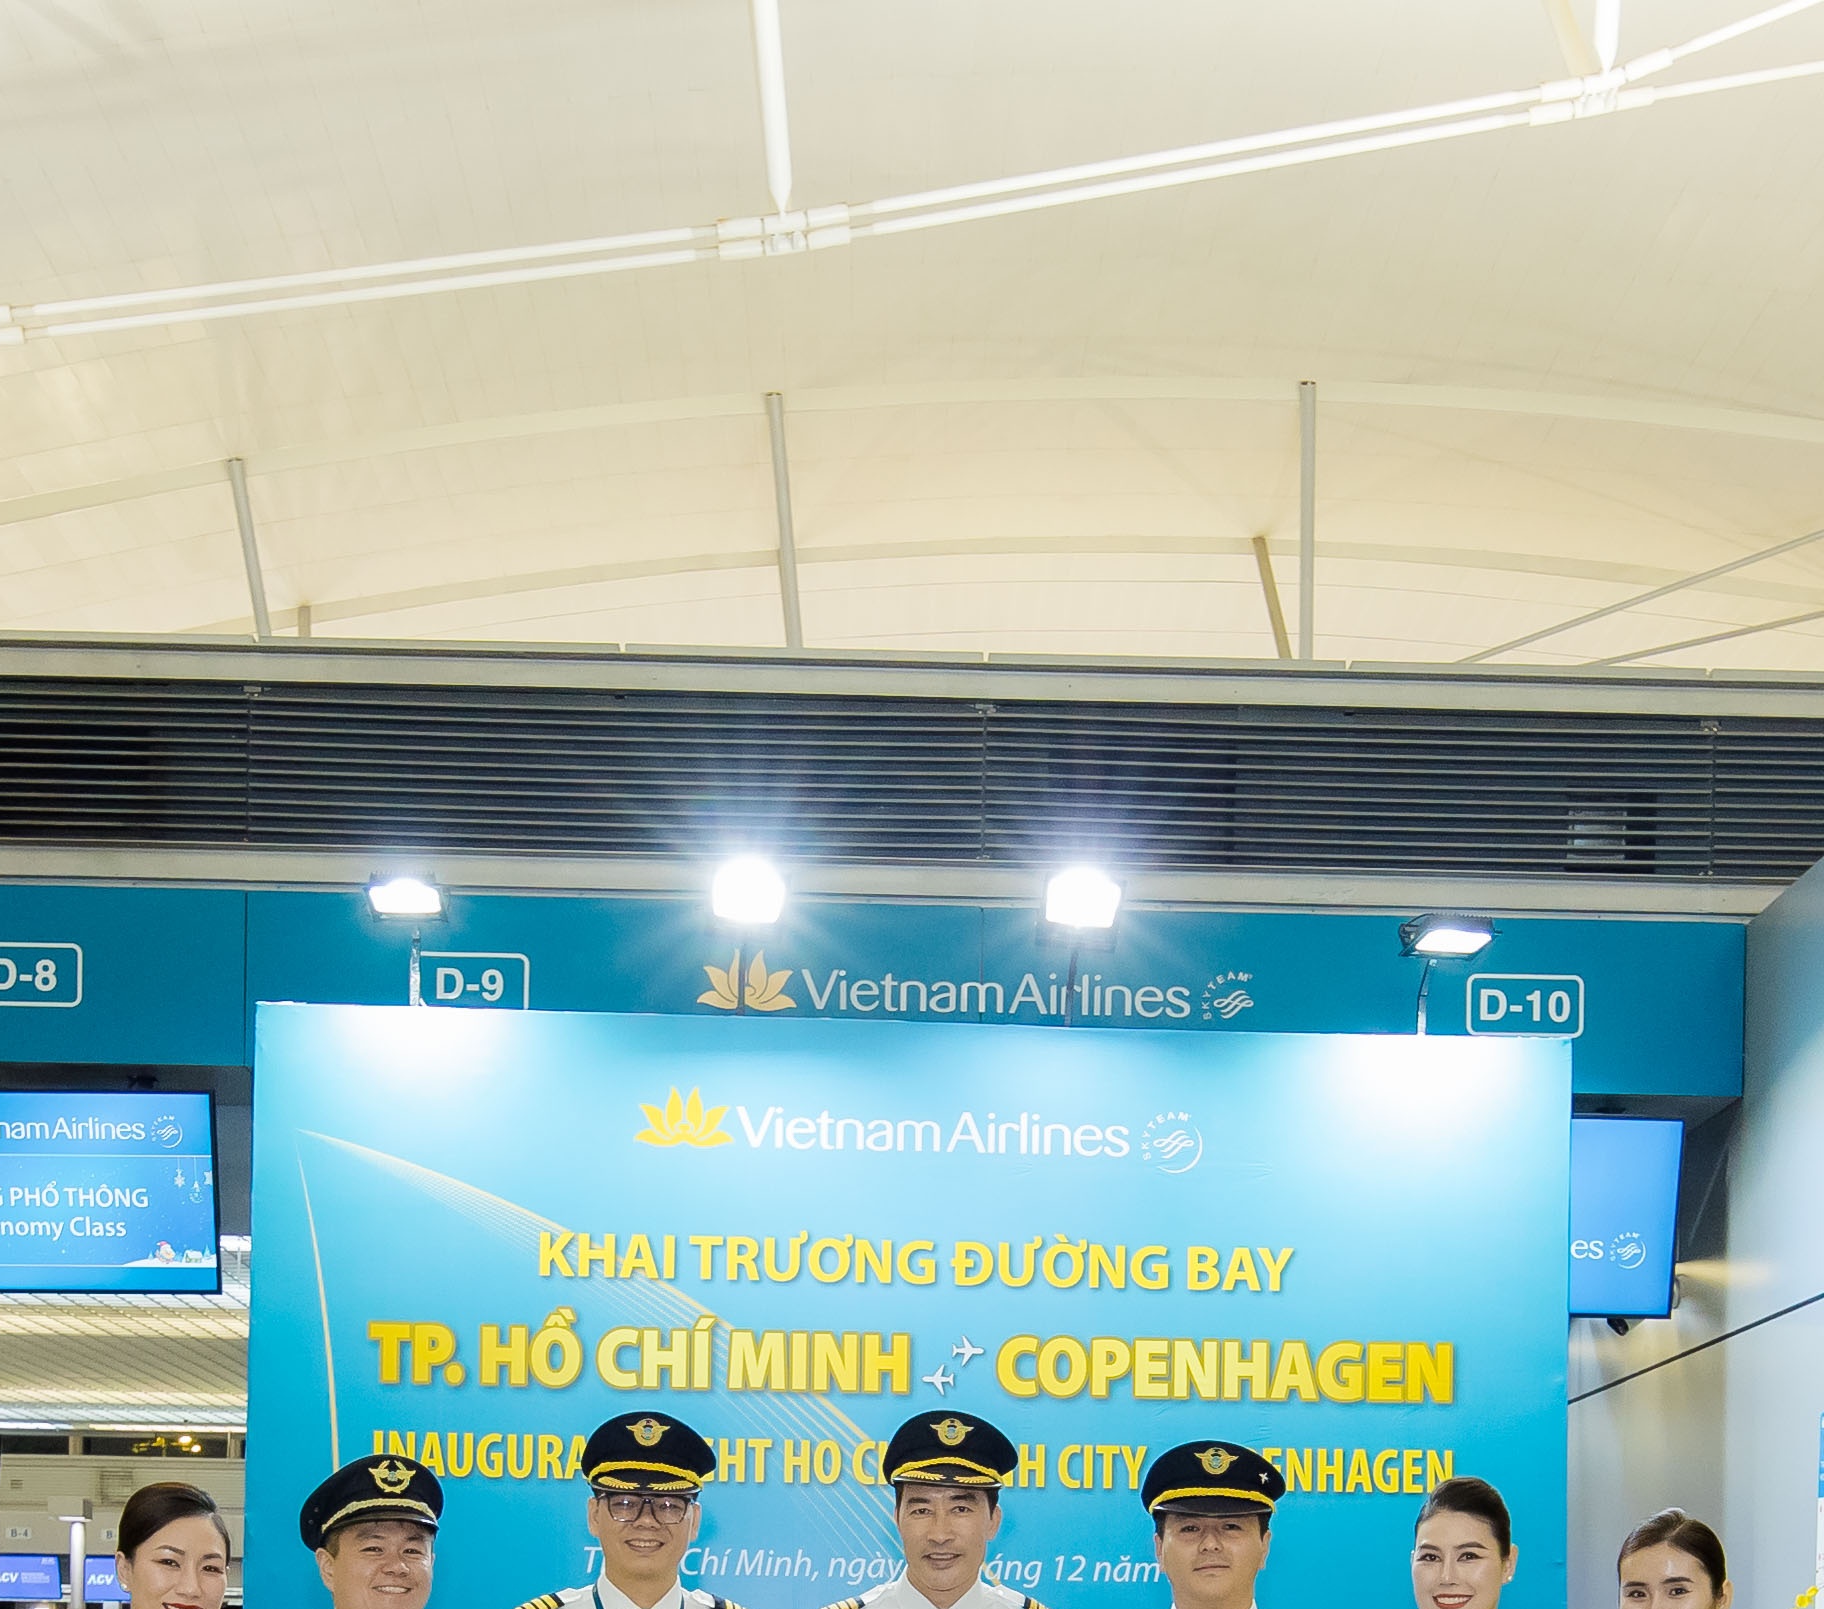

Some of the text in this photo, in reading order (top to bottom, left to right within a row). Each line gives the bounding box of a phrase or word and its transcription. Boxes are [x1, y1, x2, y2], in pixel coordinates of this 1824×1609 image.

[435, 968, 505, 1002] D-9
[801, 969, 1191, 1019] Vietnam Airlines
[1477, 988, 1570, 1025] D-10
[52, 1117, 146, 1141] Airlines
[735, 1105, 1131, 1158] Vietnam Airlines
[9, 1181, 59, 1207] PHỔ
[63, 1184, 149, 1208] THÔNG
[69, 1216, 127, 1237] Class
[538, 1230, 1295, 1293] KHAI TRƯƠNG ĐƯỜNG BAY
[368, 1306, 1454, 1405] TP. HỒ CHÍ MINH COPENHAGEN
[373, 1430, 588, 1480] INAUGURA
[784, 1438, 842, 1486] HO
[1057, 1444, 1147, 1490] CITY
[679, 1547, 733, 1576] Chí
[735, 1548, 820, 1582] Minh,
[1055, 1556, 1090, 1581] 12
[1093, 1559, 1161, 1583] năm
